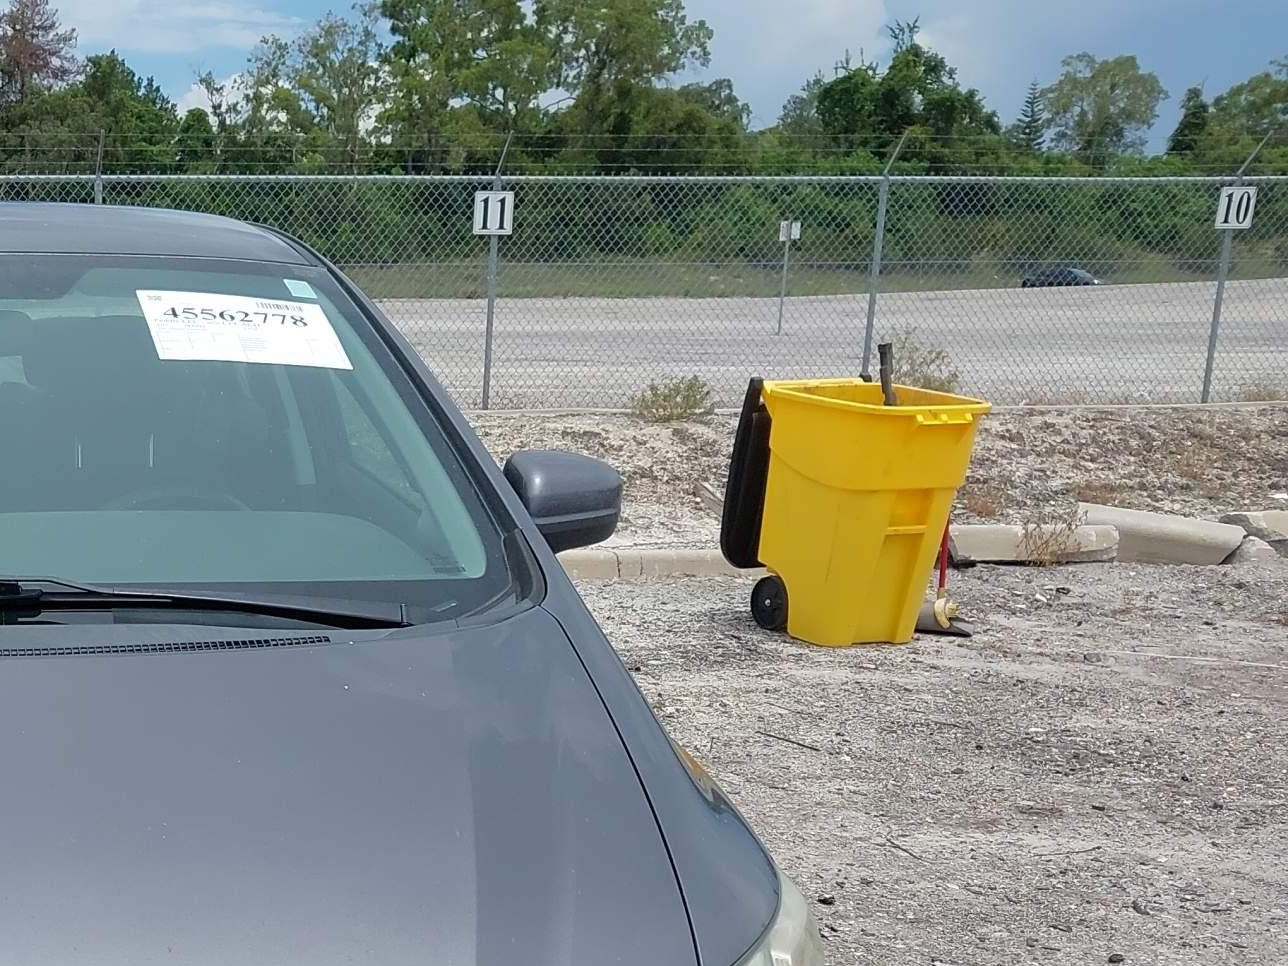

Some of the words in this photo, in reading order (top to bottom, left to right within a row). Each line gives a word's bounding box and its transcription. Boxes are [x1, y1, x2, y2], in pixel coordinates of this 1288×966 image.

[478, 195, 507, 231] 11
[1219, 190, 1251, 225] 10
[163, 305, 308, 327] 45562778
